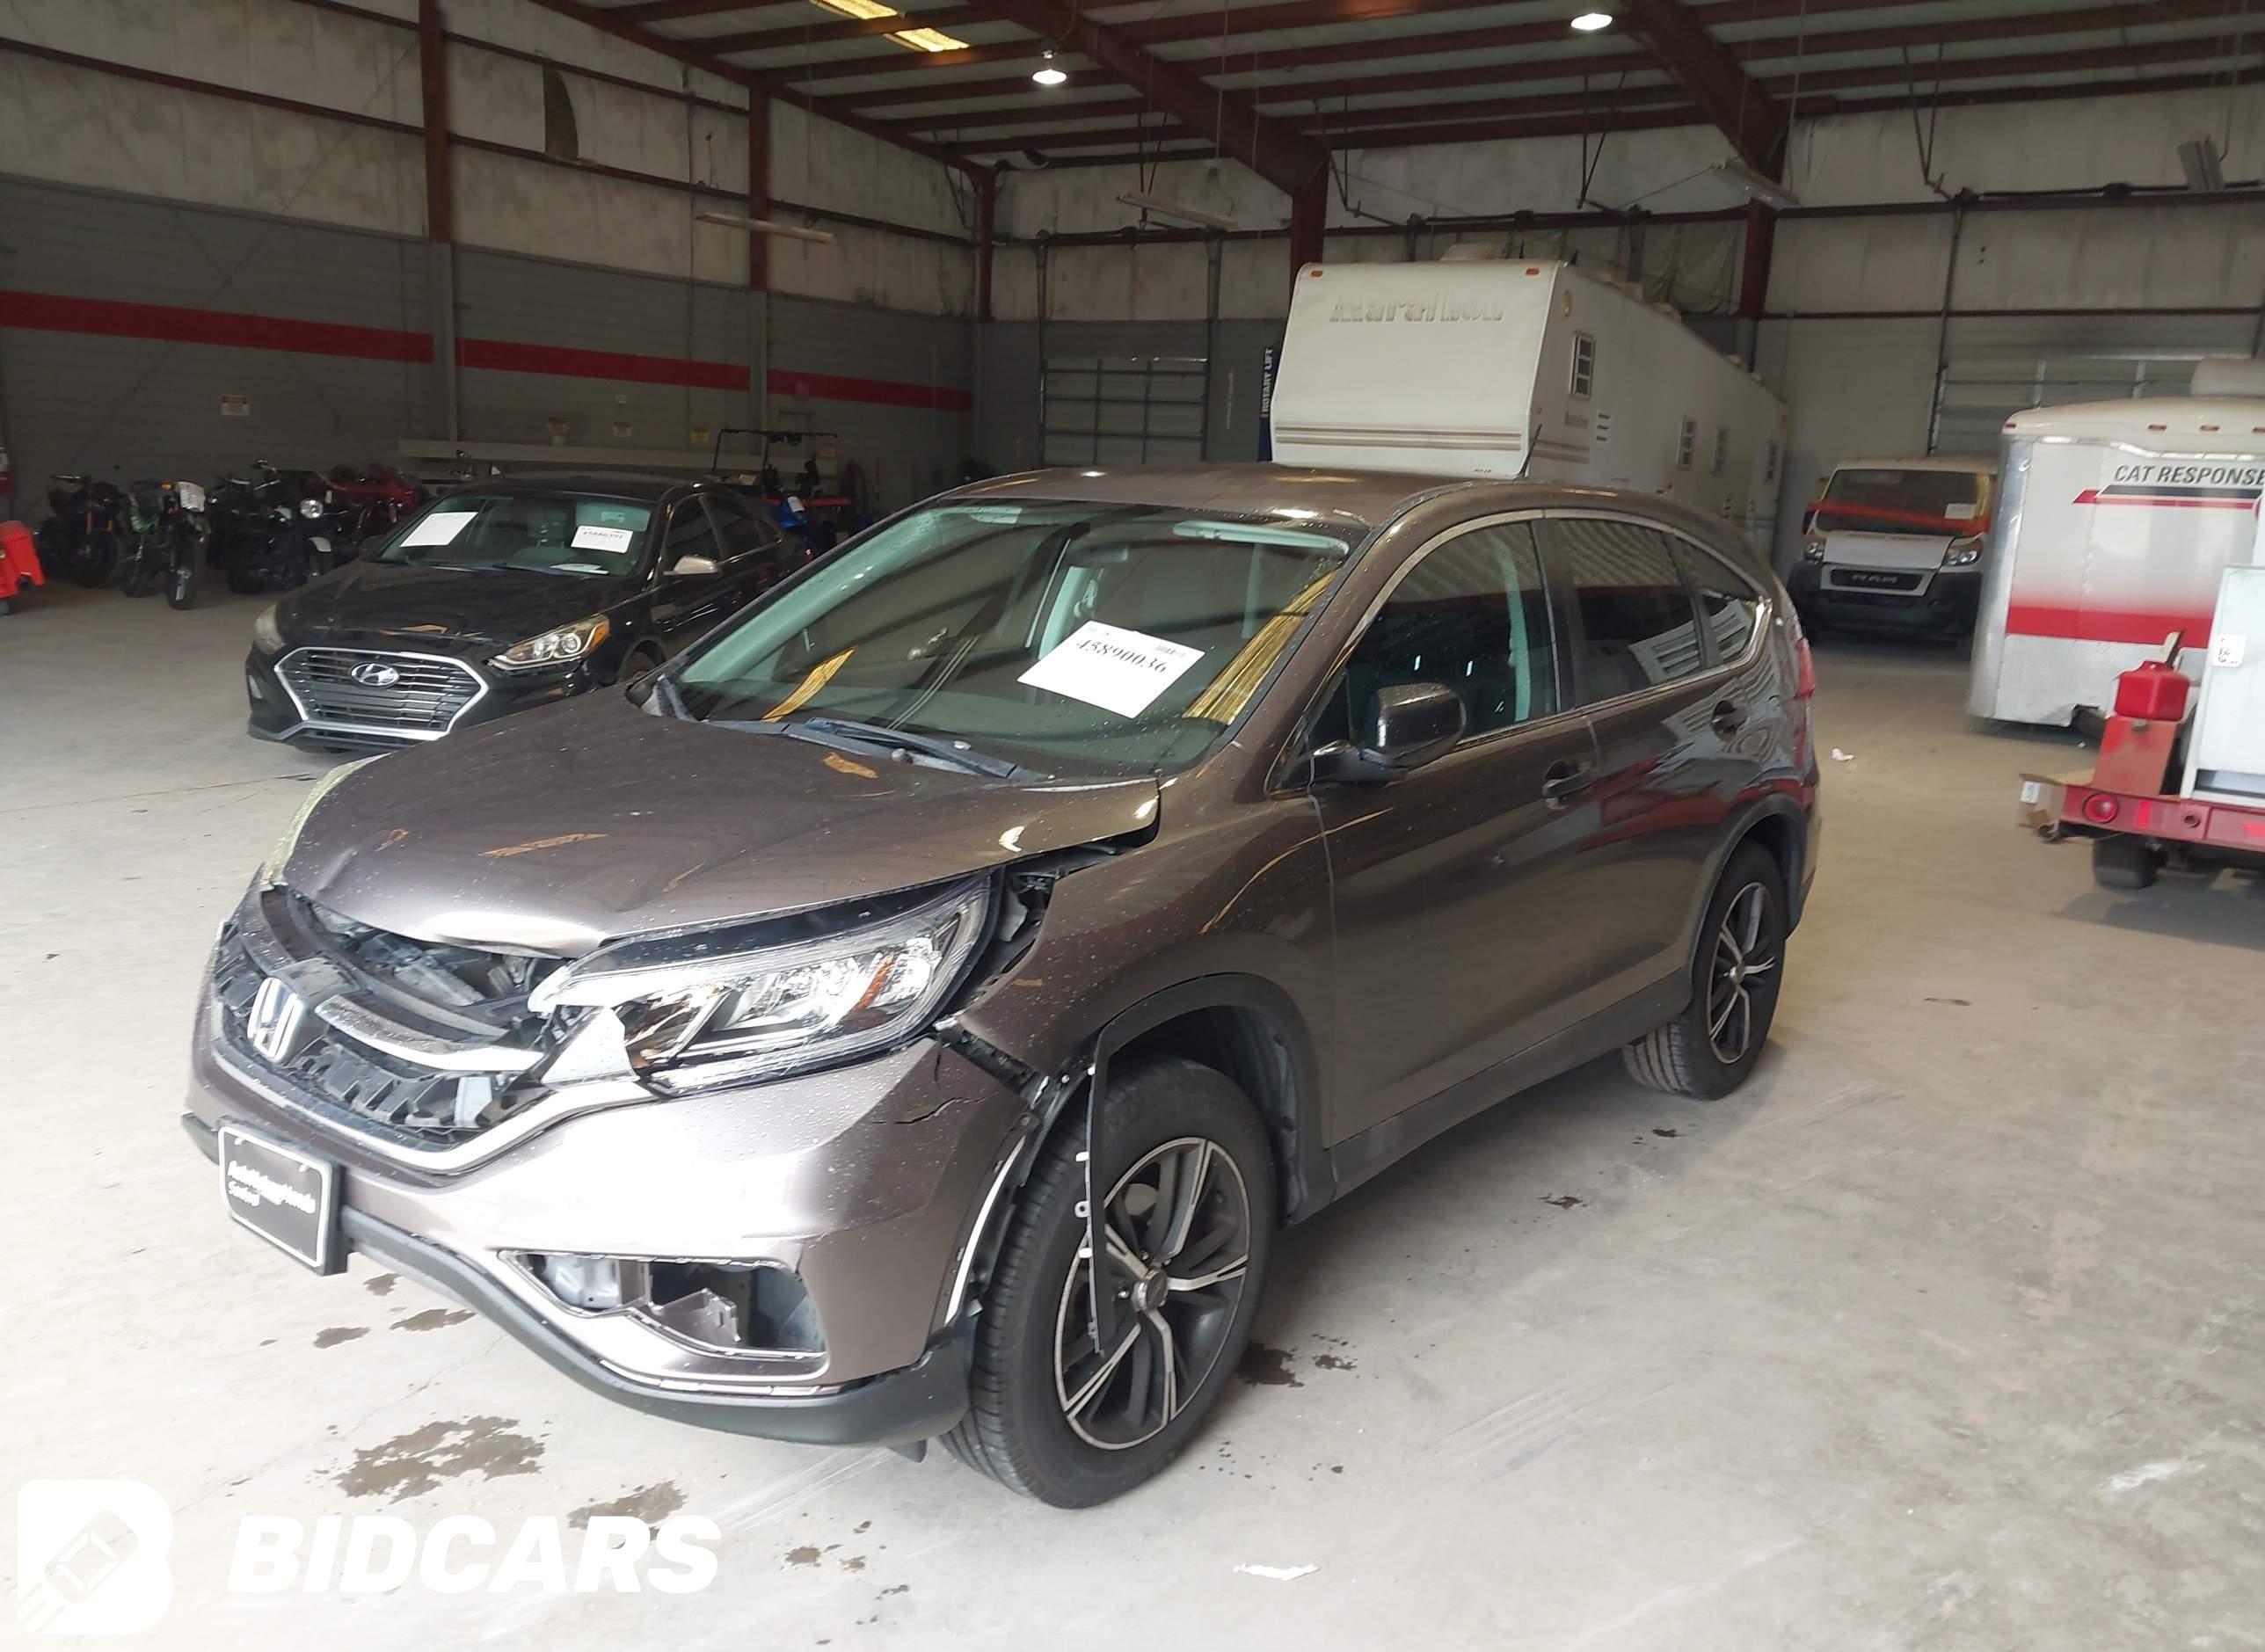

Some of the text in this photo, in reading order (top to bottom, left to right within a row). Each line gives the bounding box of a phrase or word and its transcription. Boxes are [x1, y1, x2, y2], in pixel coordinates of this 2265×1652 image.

[1261, 348, 1273, 412] ROTARY LIFT
[2115, 464, 2155, 483] CAT
[1851, 572, 1898, 585] RAM
[1076, 639, 1167, 673] 45890036
